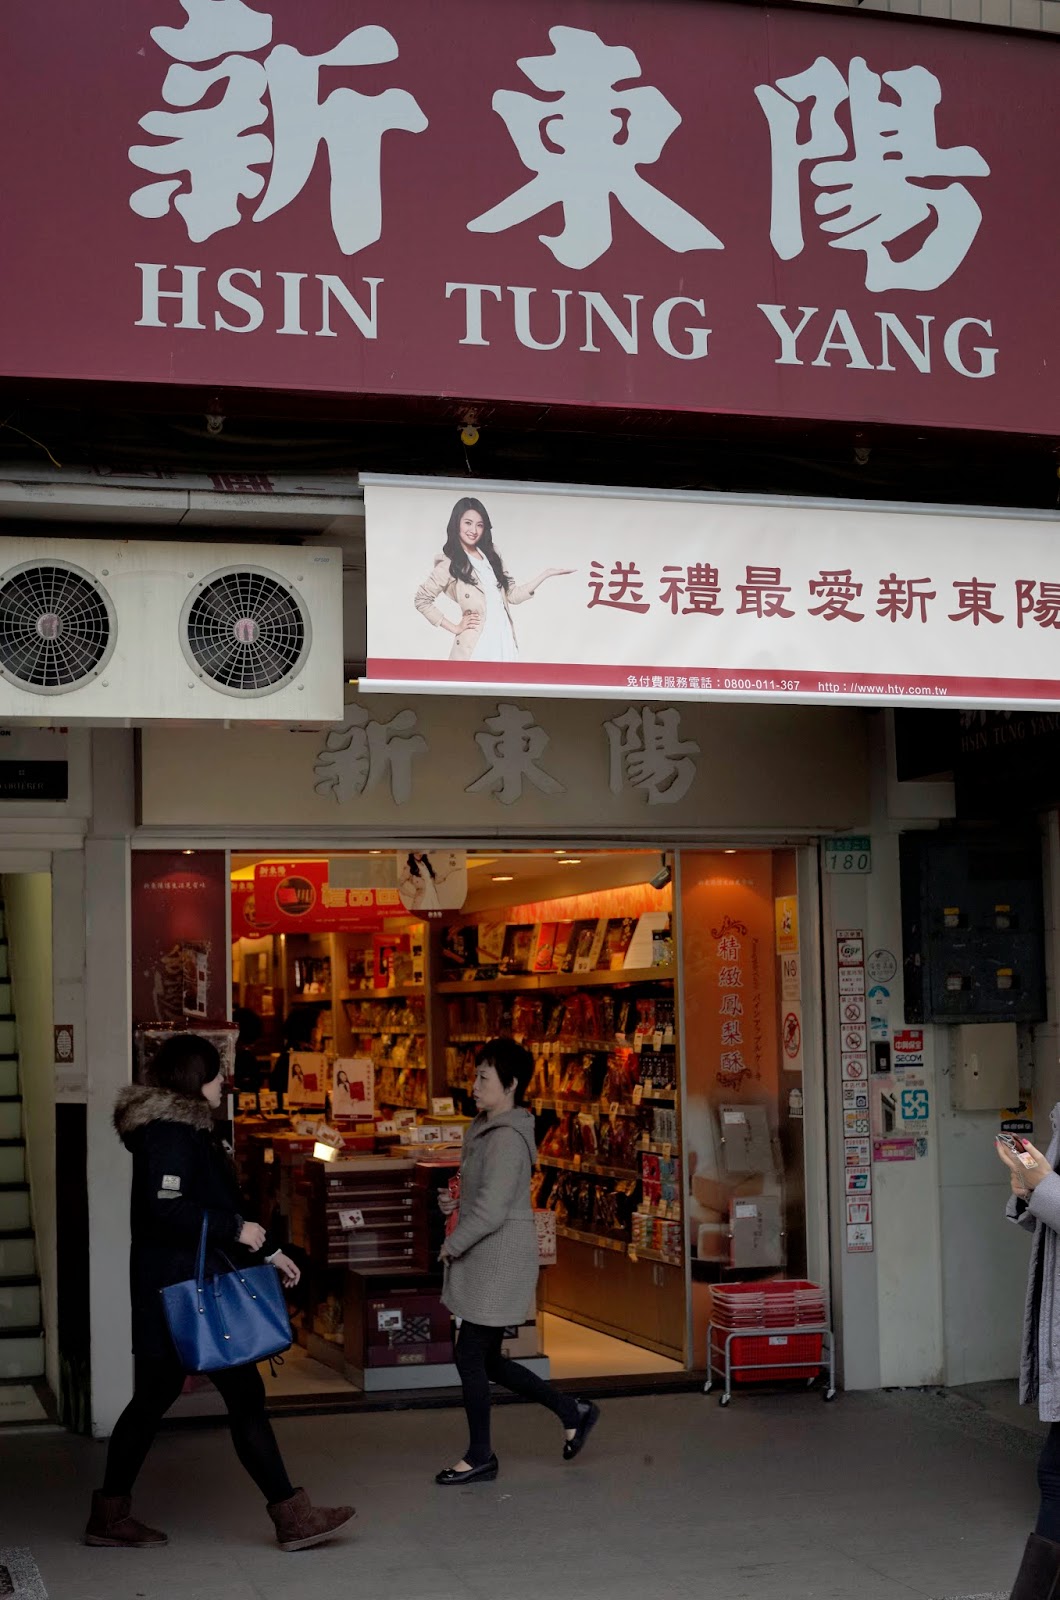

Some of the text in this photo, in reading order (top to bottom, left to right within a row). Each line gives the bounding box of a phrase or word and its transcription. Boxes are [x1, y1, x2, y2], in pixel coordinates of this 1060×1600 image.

[128, 0, 990, 292] 新東陽
[134, 263, 999, 378] HSIN TUNG YANG
[588, 560, 1060, 629] 送禮最愛新東陽
[314, 702, 701, 805] 新東陽
[992, 721, 1025, 744] TUNG
[832, 854, 867, 870] 180
[717, 936, 746, 1072] 精緻鳳梨酥
[895, 1054, 922, 1062] SECOM
